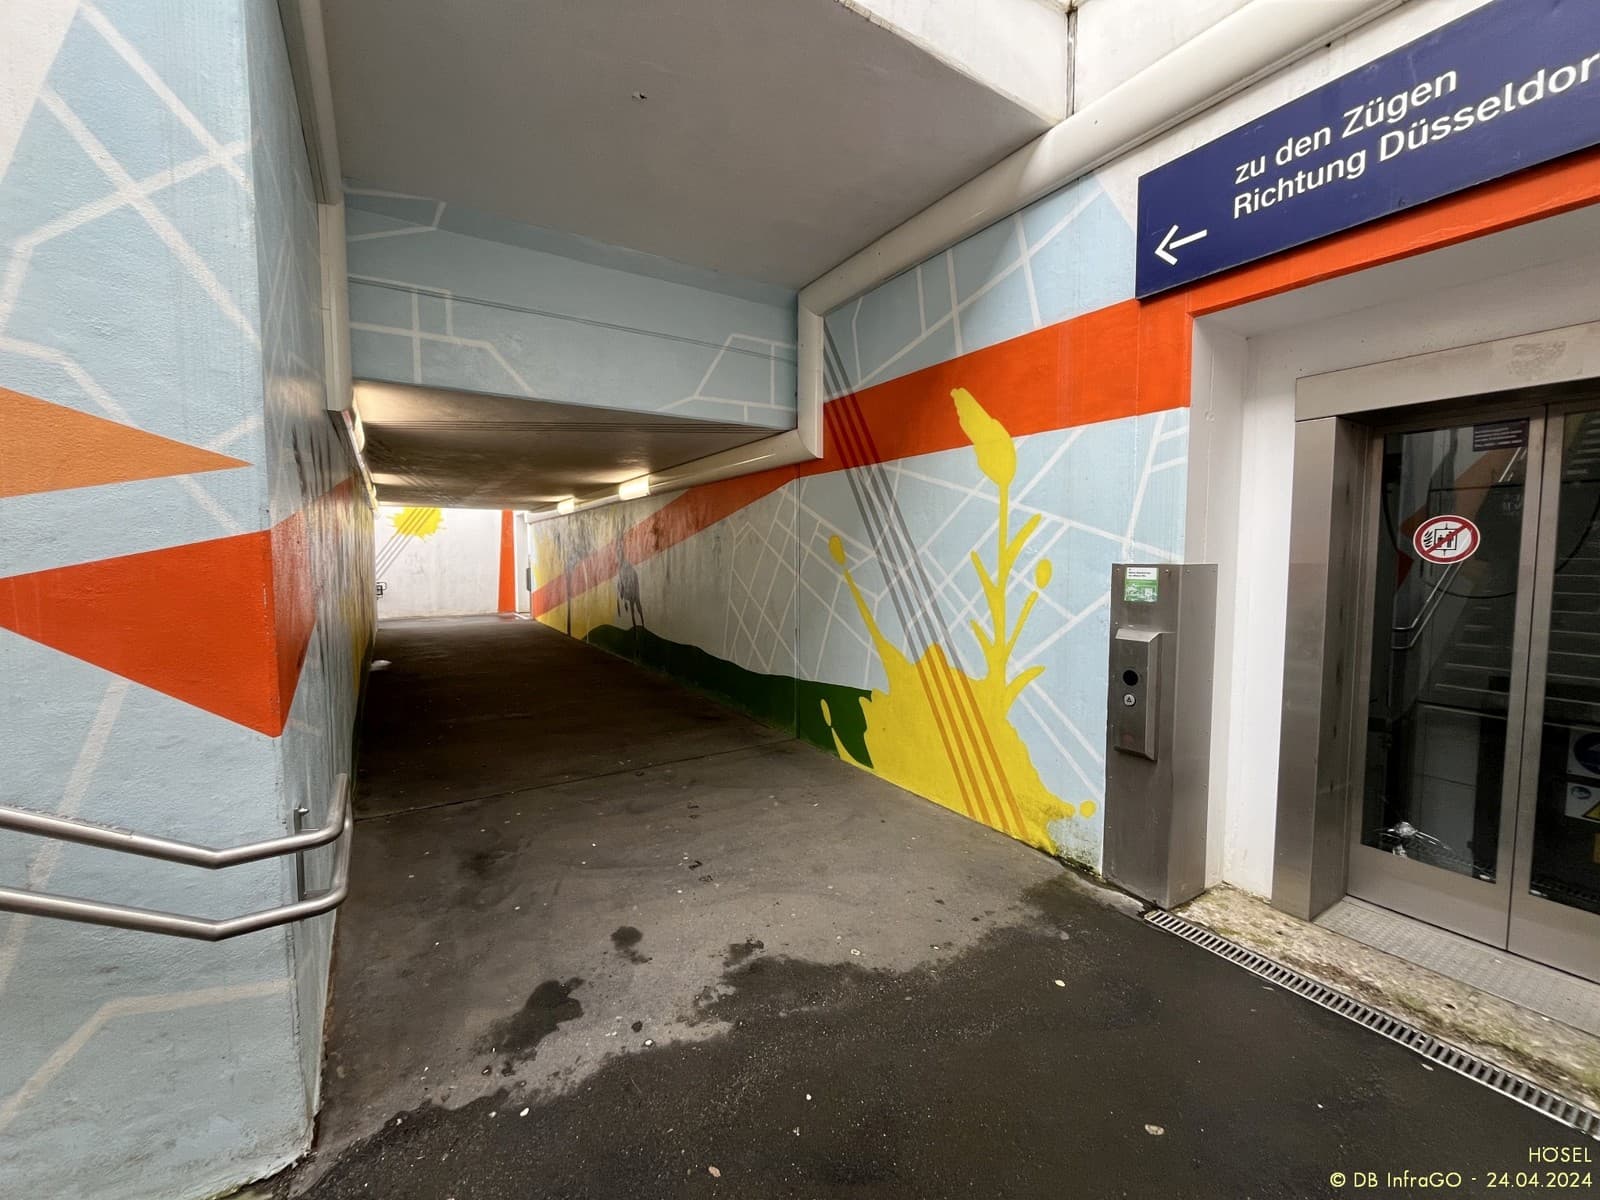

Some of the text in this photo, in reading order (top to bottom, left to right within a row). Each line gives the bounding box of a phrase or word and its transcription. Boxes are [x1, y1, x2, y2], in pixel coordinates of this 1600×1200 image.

[1233, 52, 1600, 219] Richtung Düsseldor
[1235, 70, 1457, 185] zu den Zügen
